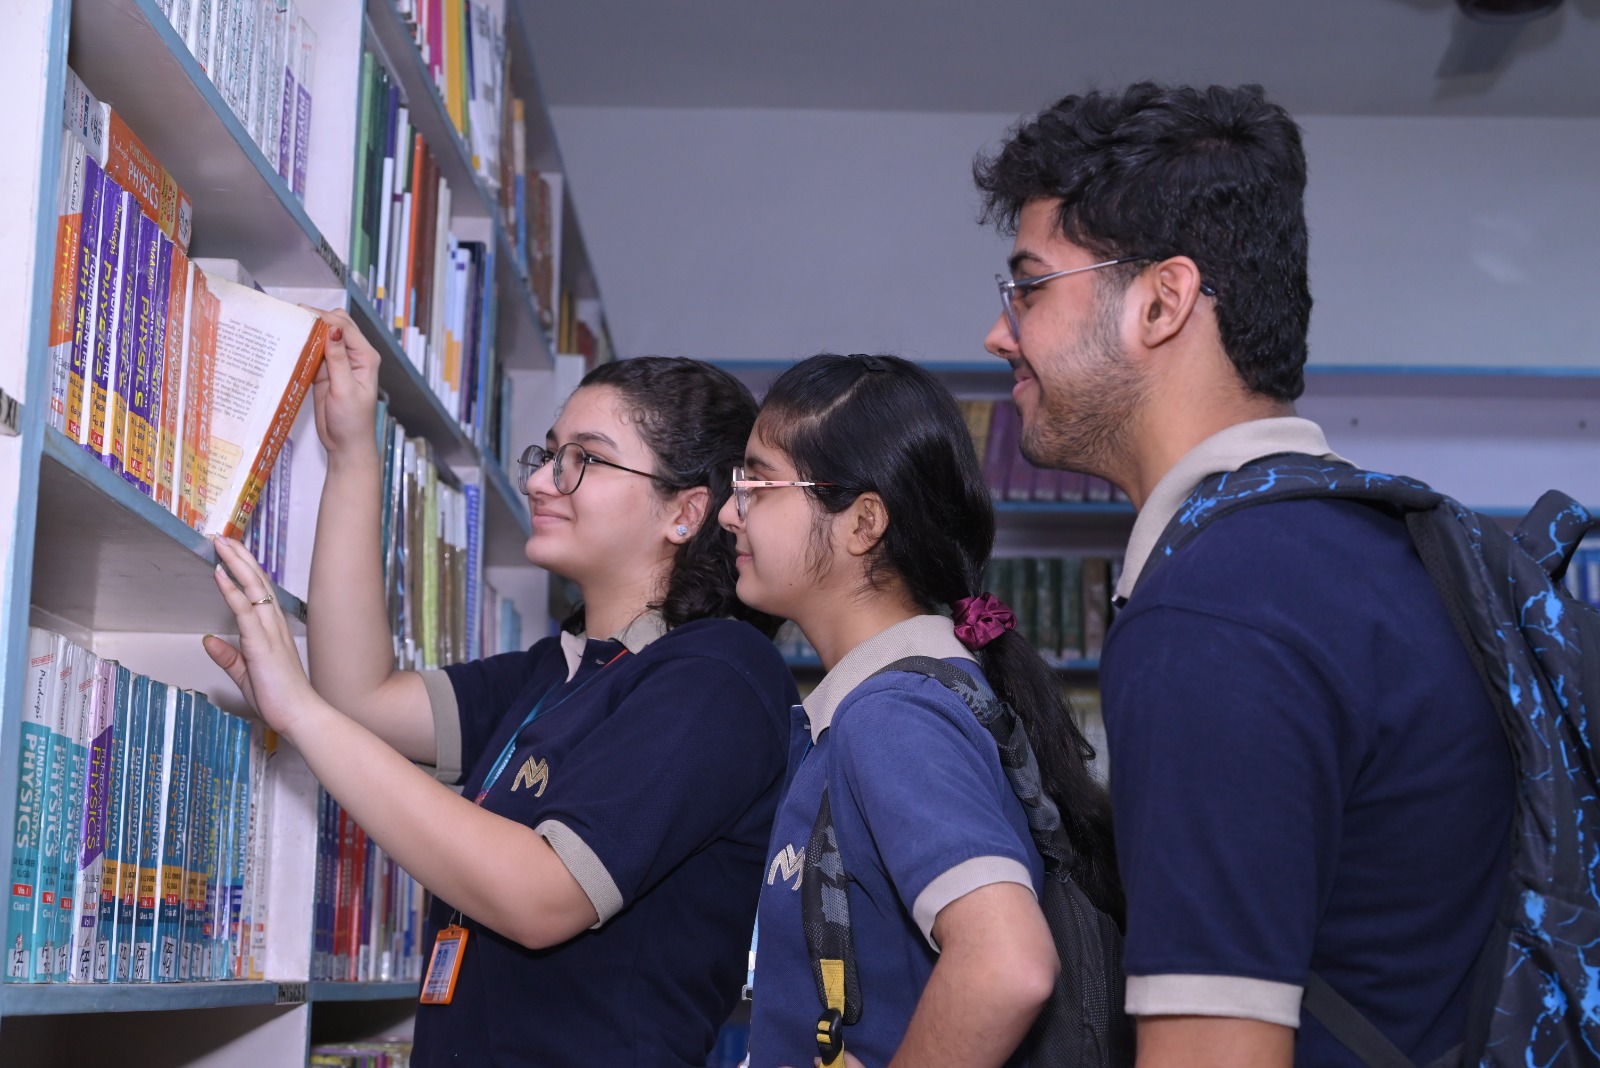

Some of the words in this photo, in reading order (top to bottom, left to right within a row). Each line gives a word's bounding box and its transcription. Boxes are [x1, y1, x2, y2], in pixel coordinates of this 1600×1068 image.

[295, 94, 307, 170] PHYSICS
[128, 160, 159, 210] PHYSICS
[134, 295, 149, 408] PHYSICS
[199, 353, 210, 452] PHYSICS
[258, 380, 299, 471] PHYSICS
[264, 386, 305, 473] FUNDAMENTAL
[34, 669, 46, 719] Pradeep's
[16, 733, 38, 849] PHYSICS
[45, 744, 62, 858] PHYSICS
[63, 754, 80, 864] PHYSICS
[87, 745, 102, 850] PHYSICS
[110, 739, 124, 851] FUNDAMENTAL
[131, 746, 143, 856] FUNDAMENTAL
[151, 753, 163, 860] FUNDAMENTAL
[175, 754, 187, 858] FUNDAMENTAL
